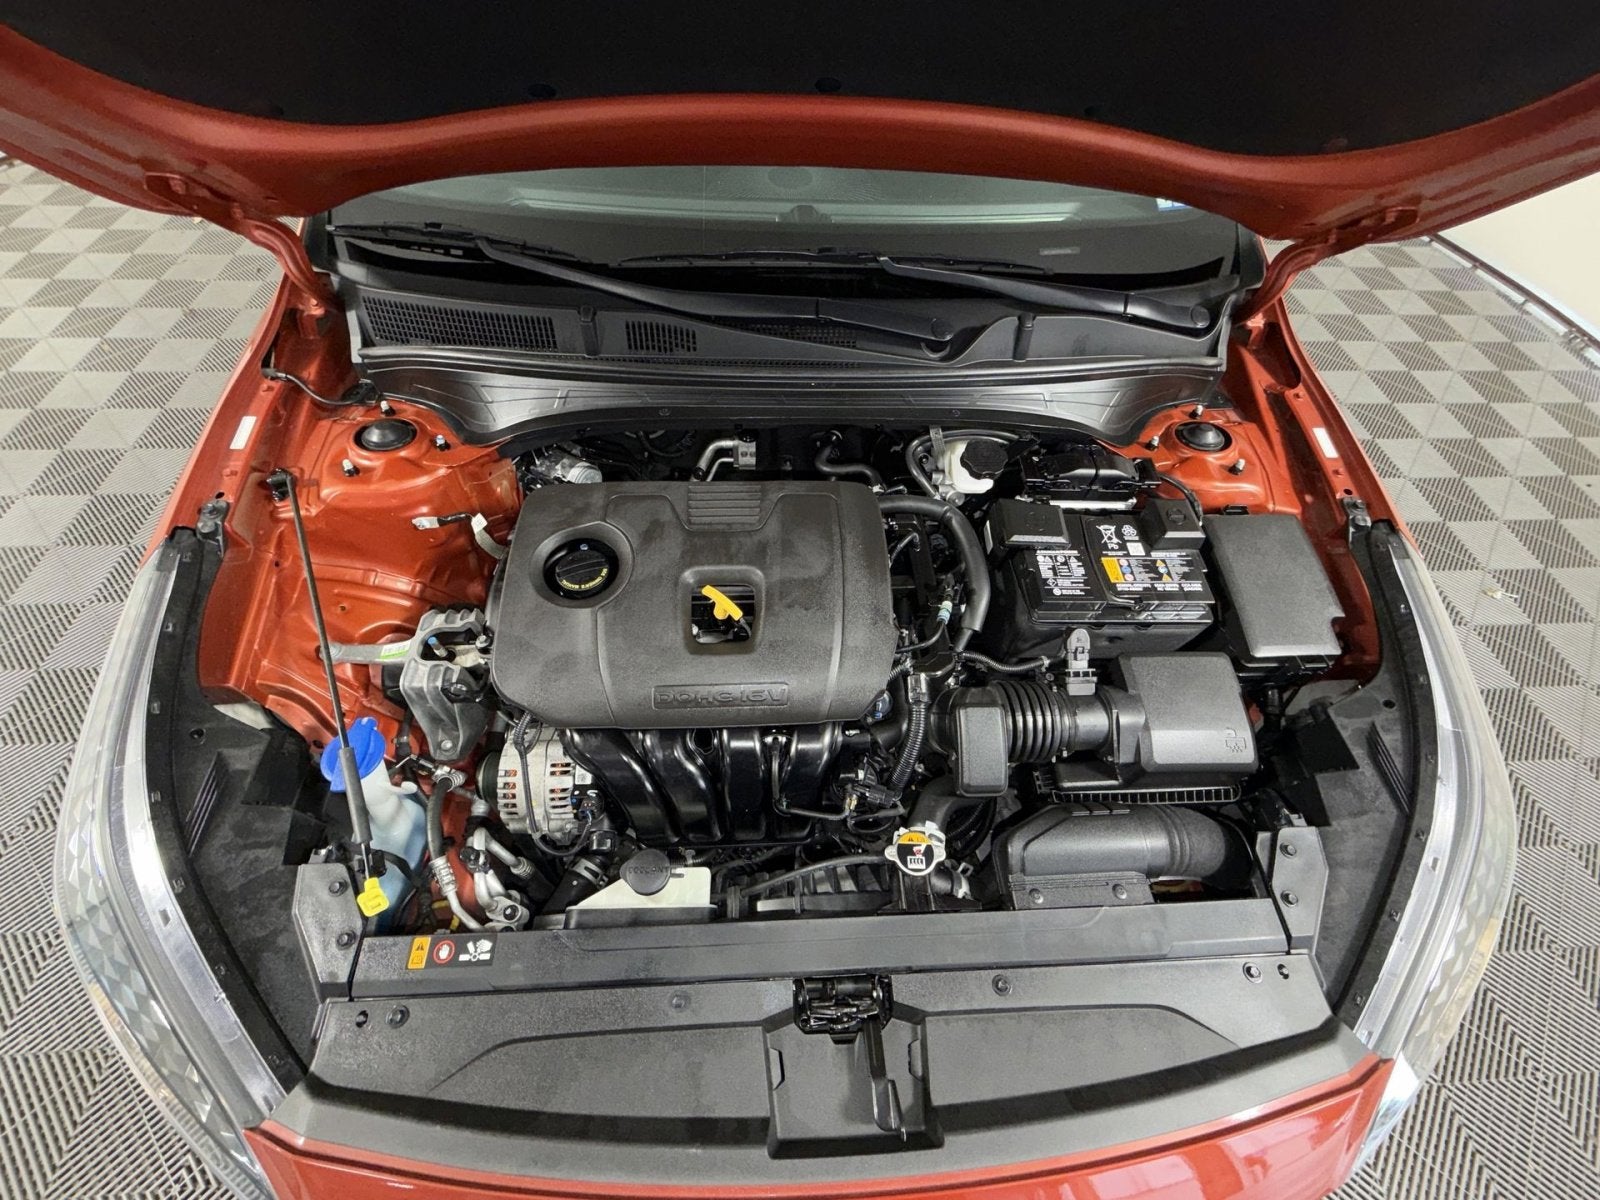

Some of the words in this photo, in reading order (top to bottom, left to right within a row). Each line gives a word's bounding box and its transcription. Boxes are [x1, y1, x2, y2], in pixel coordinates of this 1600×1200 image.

[561, 579, 580, 589] MANUAL
[655, 689, 734, 704] DOHC
[740, 687, 786, 703] 16V
